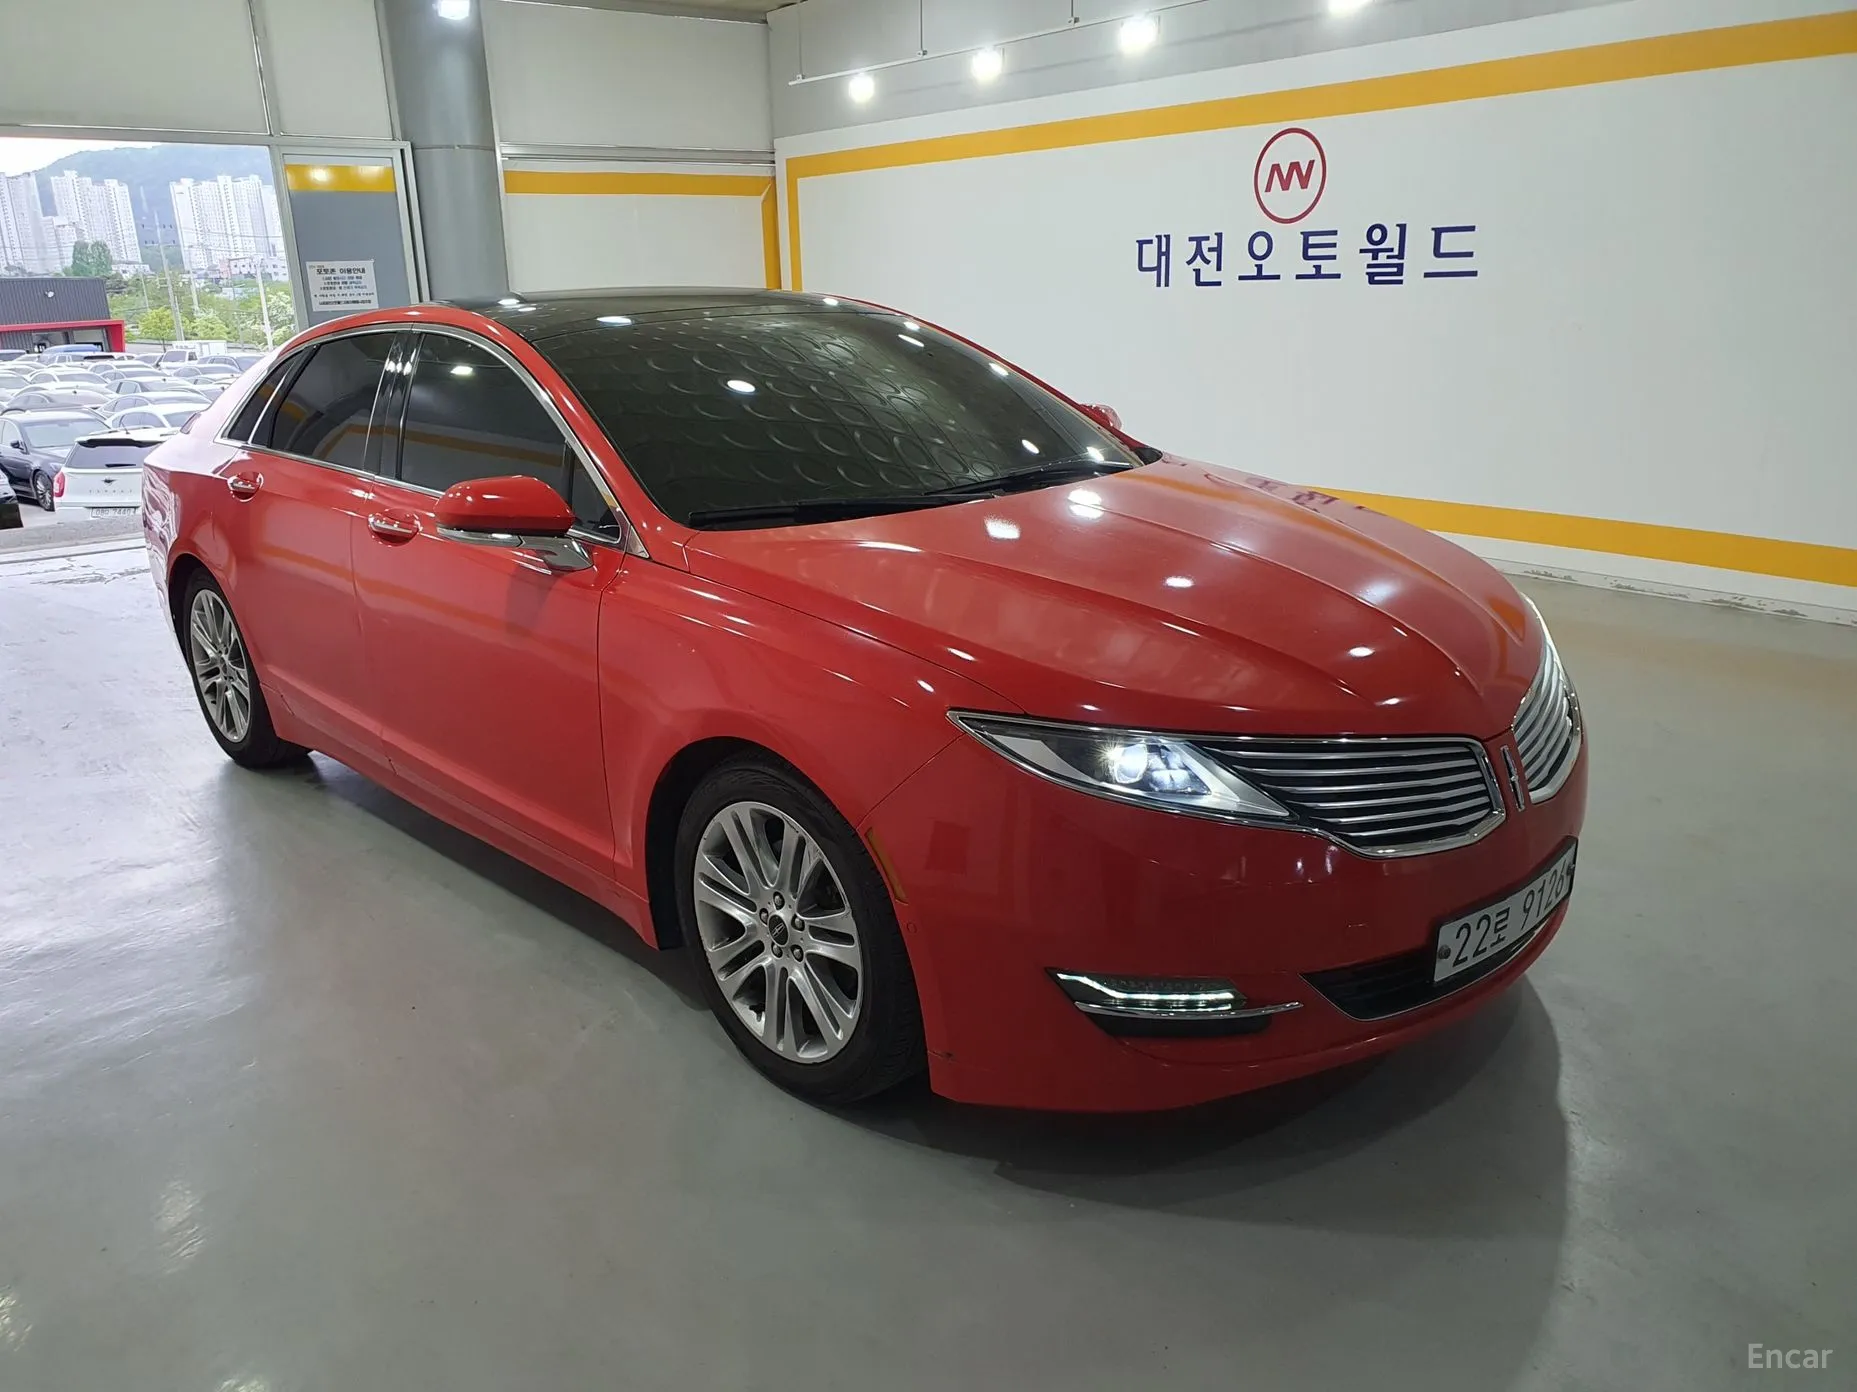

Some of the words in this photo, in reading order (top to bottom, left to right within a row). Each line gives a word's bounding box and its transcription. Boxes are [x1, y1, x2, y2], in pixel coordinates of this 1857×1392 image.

[1136, 223, 1478, 287] 대전오토월드
[1452, 907, 1511, 968] 22로
[1521, 859, 1566, 931] 9126
